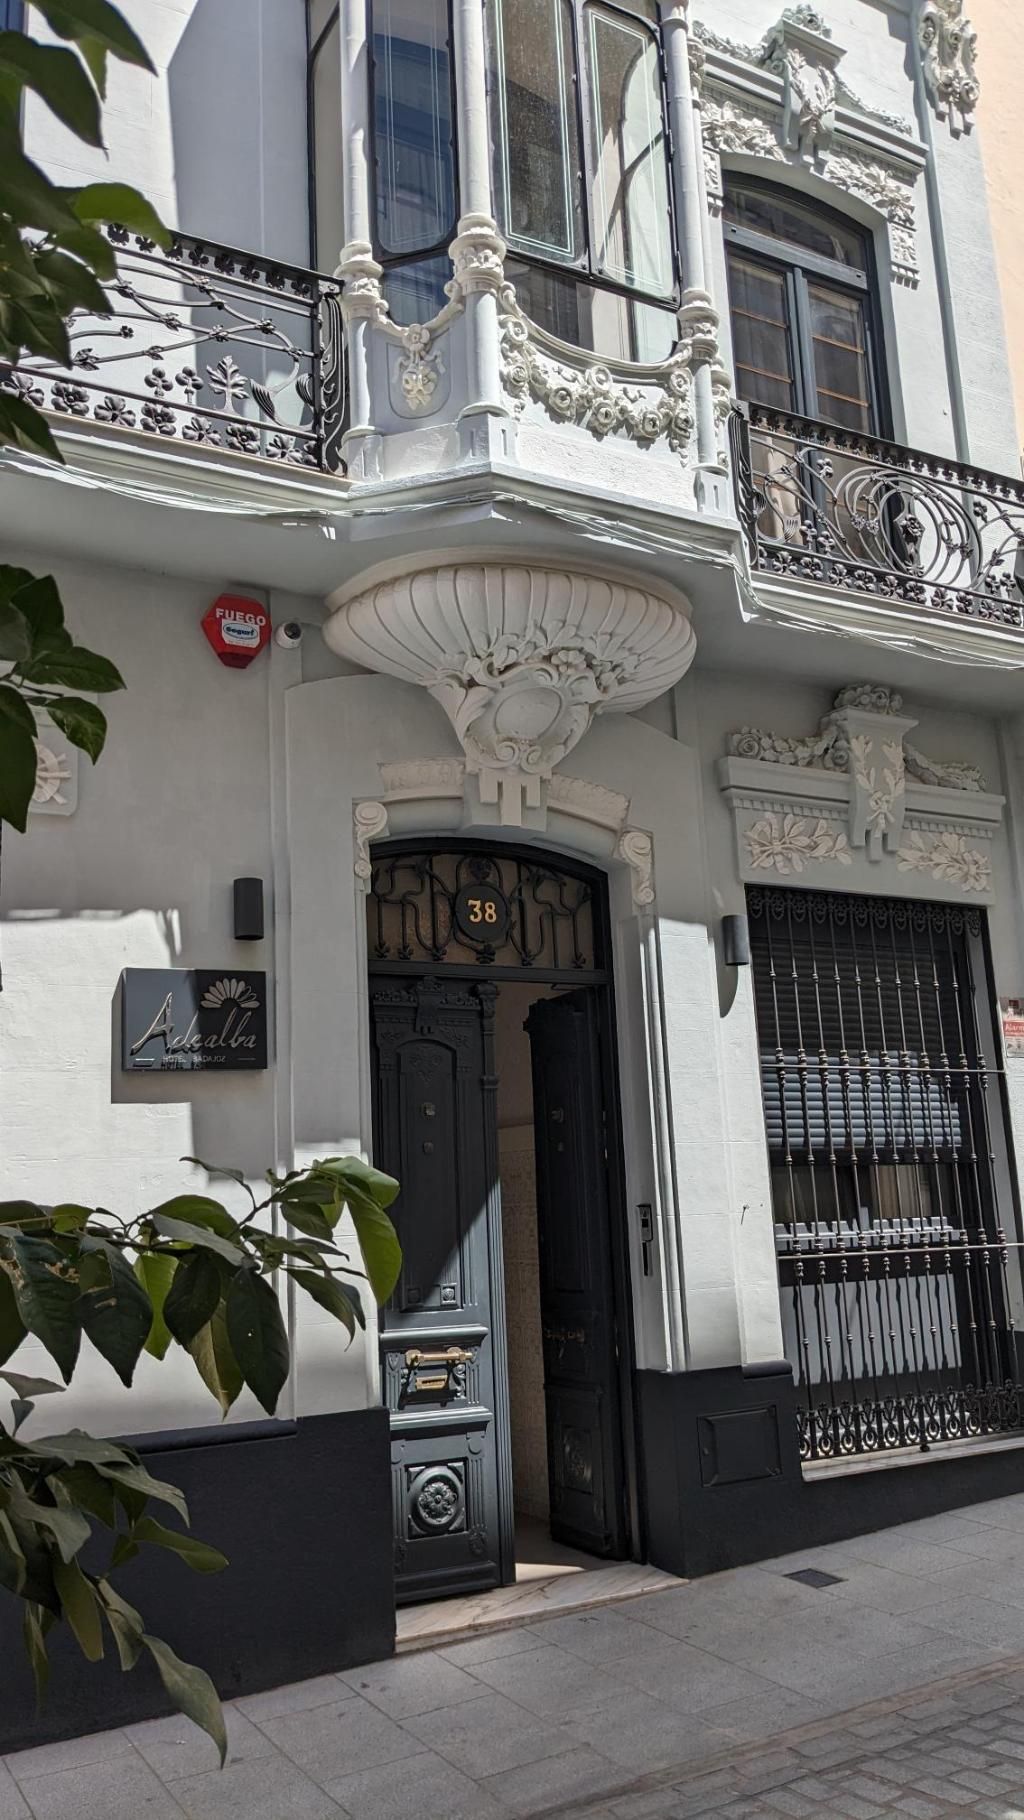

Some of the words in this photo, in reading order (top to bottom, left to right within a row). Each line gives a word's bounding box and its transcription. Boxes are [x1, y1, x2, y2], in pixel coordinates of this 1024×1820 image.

[215, 608, 266, 626] FUEGO
[468, 899, 497, 923] 38
[131, 991, 257, 1052] Adealba
[162, 1055, 187, 1063] HOTEL
[192, 1055, 226, 1063] BADAJOZ
